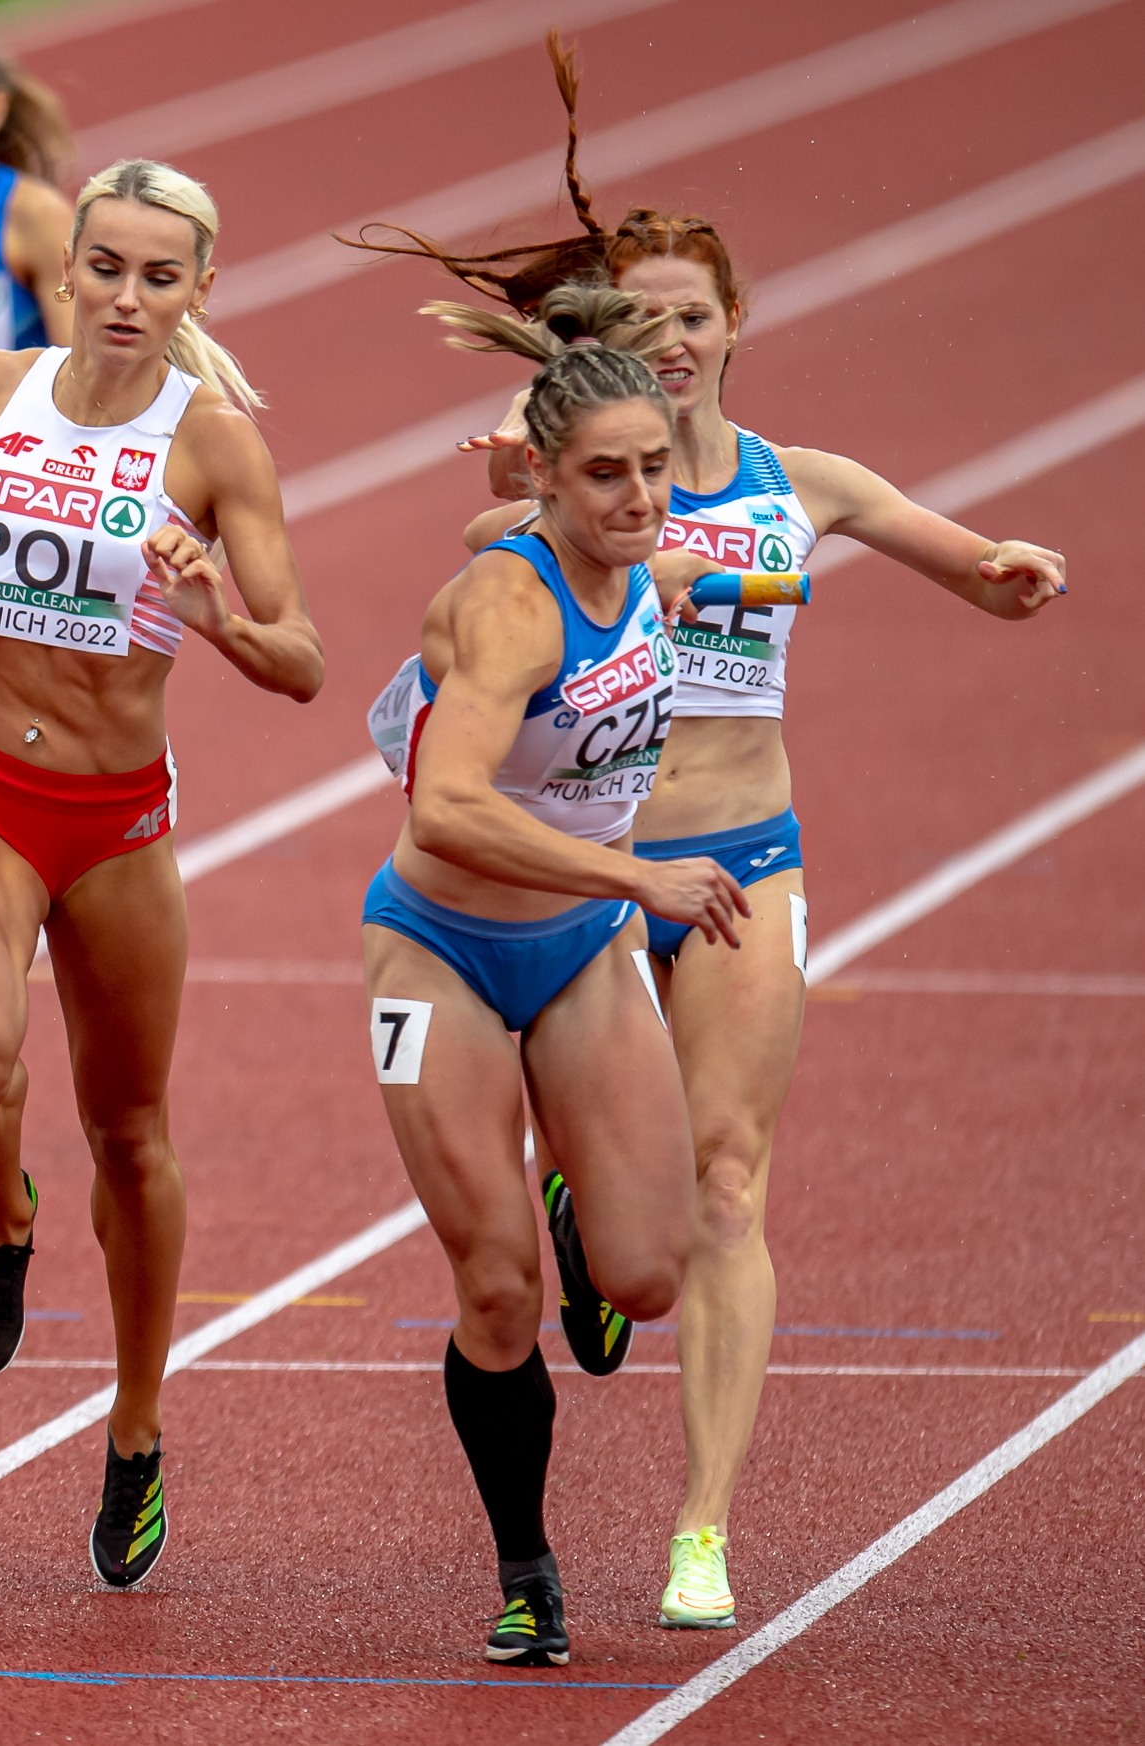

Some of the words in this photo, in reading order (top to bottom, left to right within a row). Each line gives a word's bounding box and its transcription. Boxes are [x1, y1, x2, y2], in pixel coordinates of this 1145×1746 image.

[46, 461, 91, 480] ORLEN
[657, 521, 751, 563] PAR
[55, 618, 117, 647] 2022
[571, 650, 655, 709] SPAR
[713, 659, 767, 687] 2022
[576, 685, 673, 770] CZE
[539, 774, 624, 801] MUNICH
[632, 772, 657, 794] 20
[379, 1012, 411, 1071] 7
